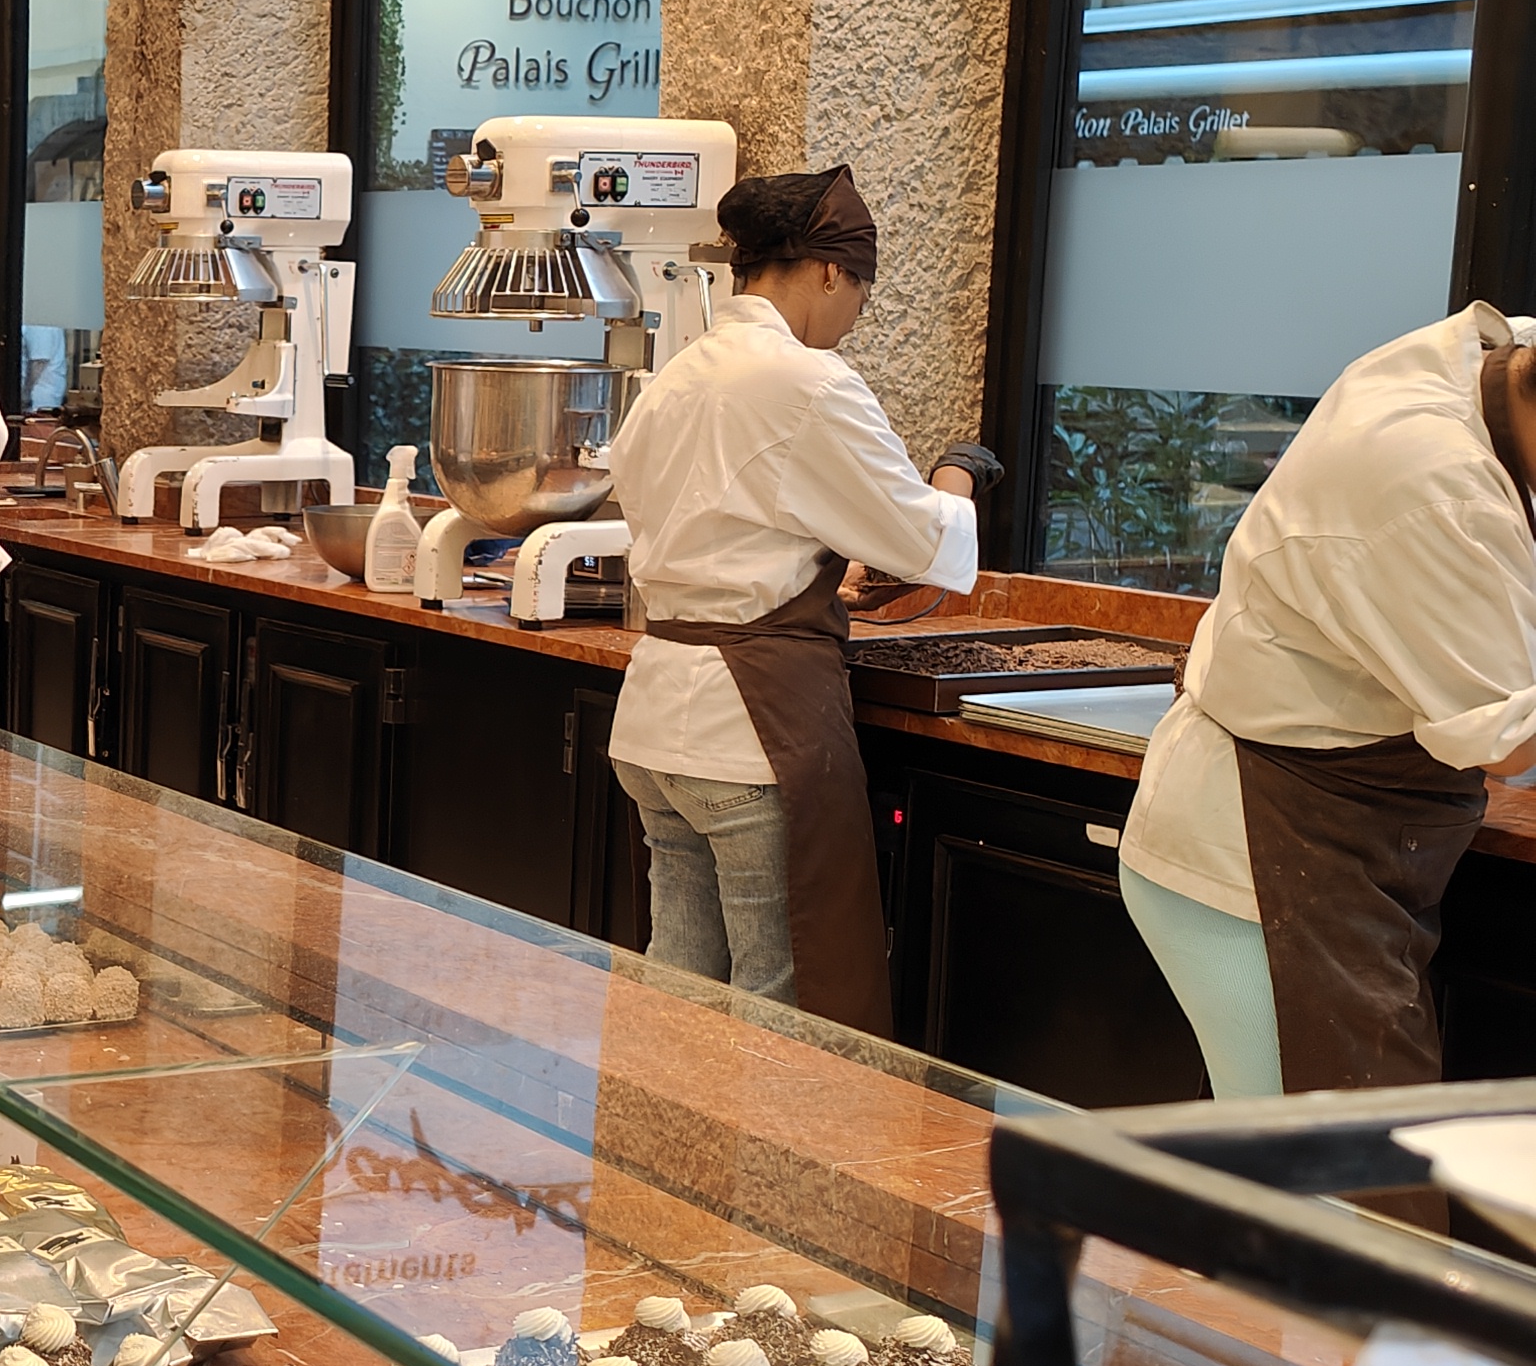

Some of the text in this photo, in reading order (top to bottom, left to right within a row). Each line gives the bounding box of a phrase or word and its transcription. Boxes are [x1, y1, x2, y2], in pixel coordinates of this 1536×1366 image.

[457, 38, 569, 91] Palais
[1120, 106, 1181, 137] Palais
[1188, 104, 1251, 143] Grillet
[633, 160, 693, 170] THUNDERBIRD
